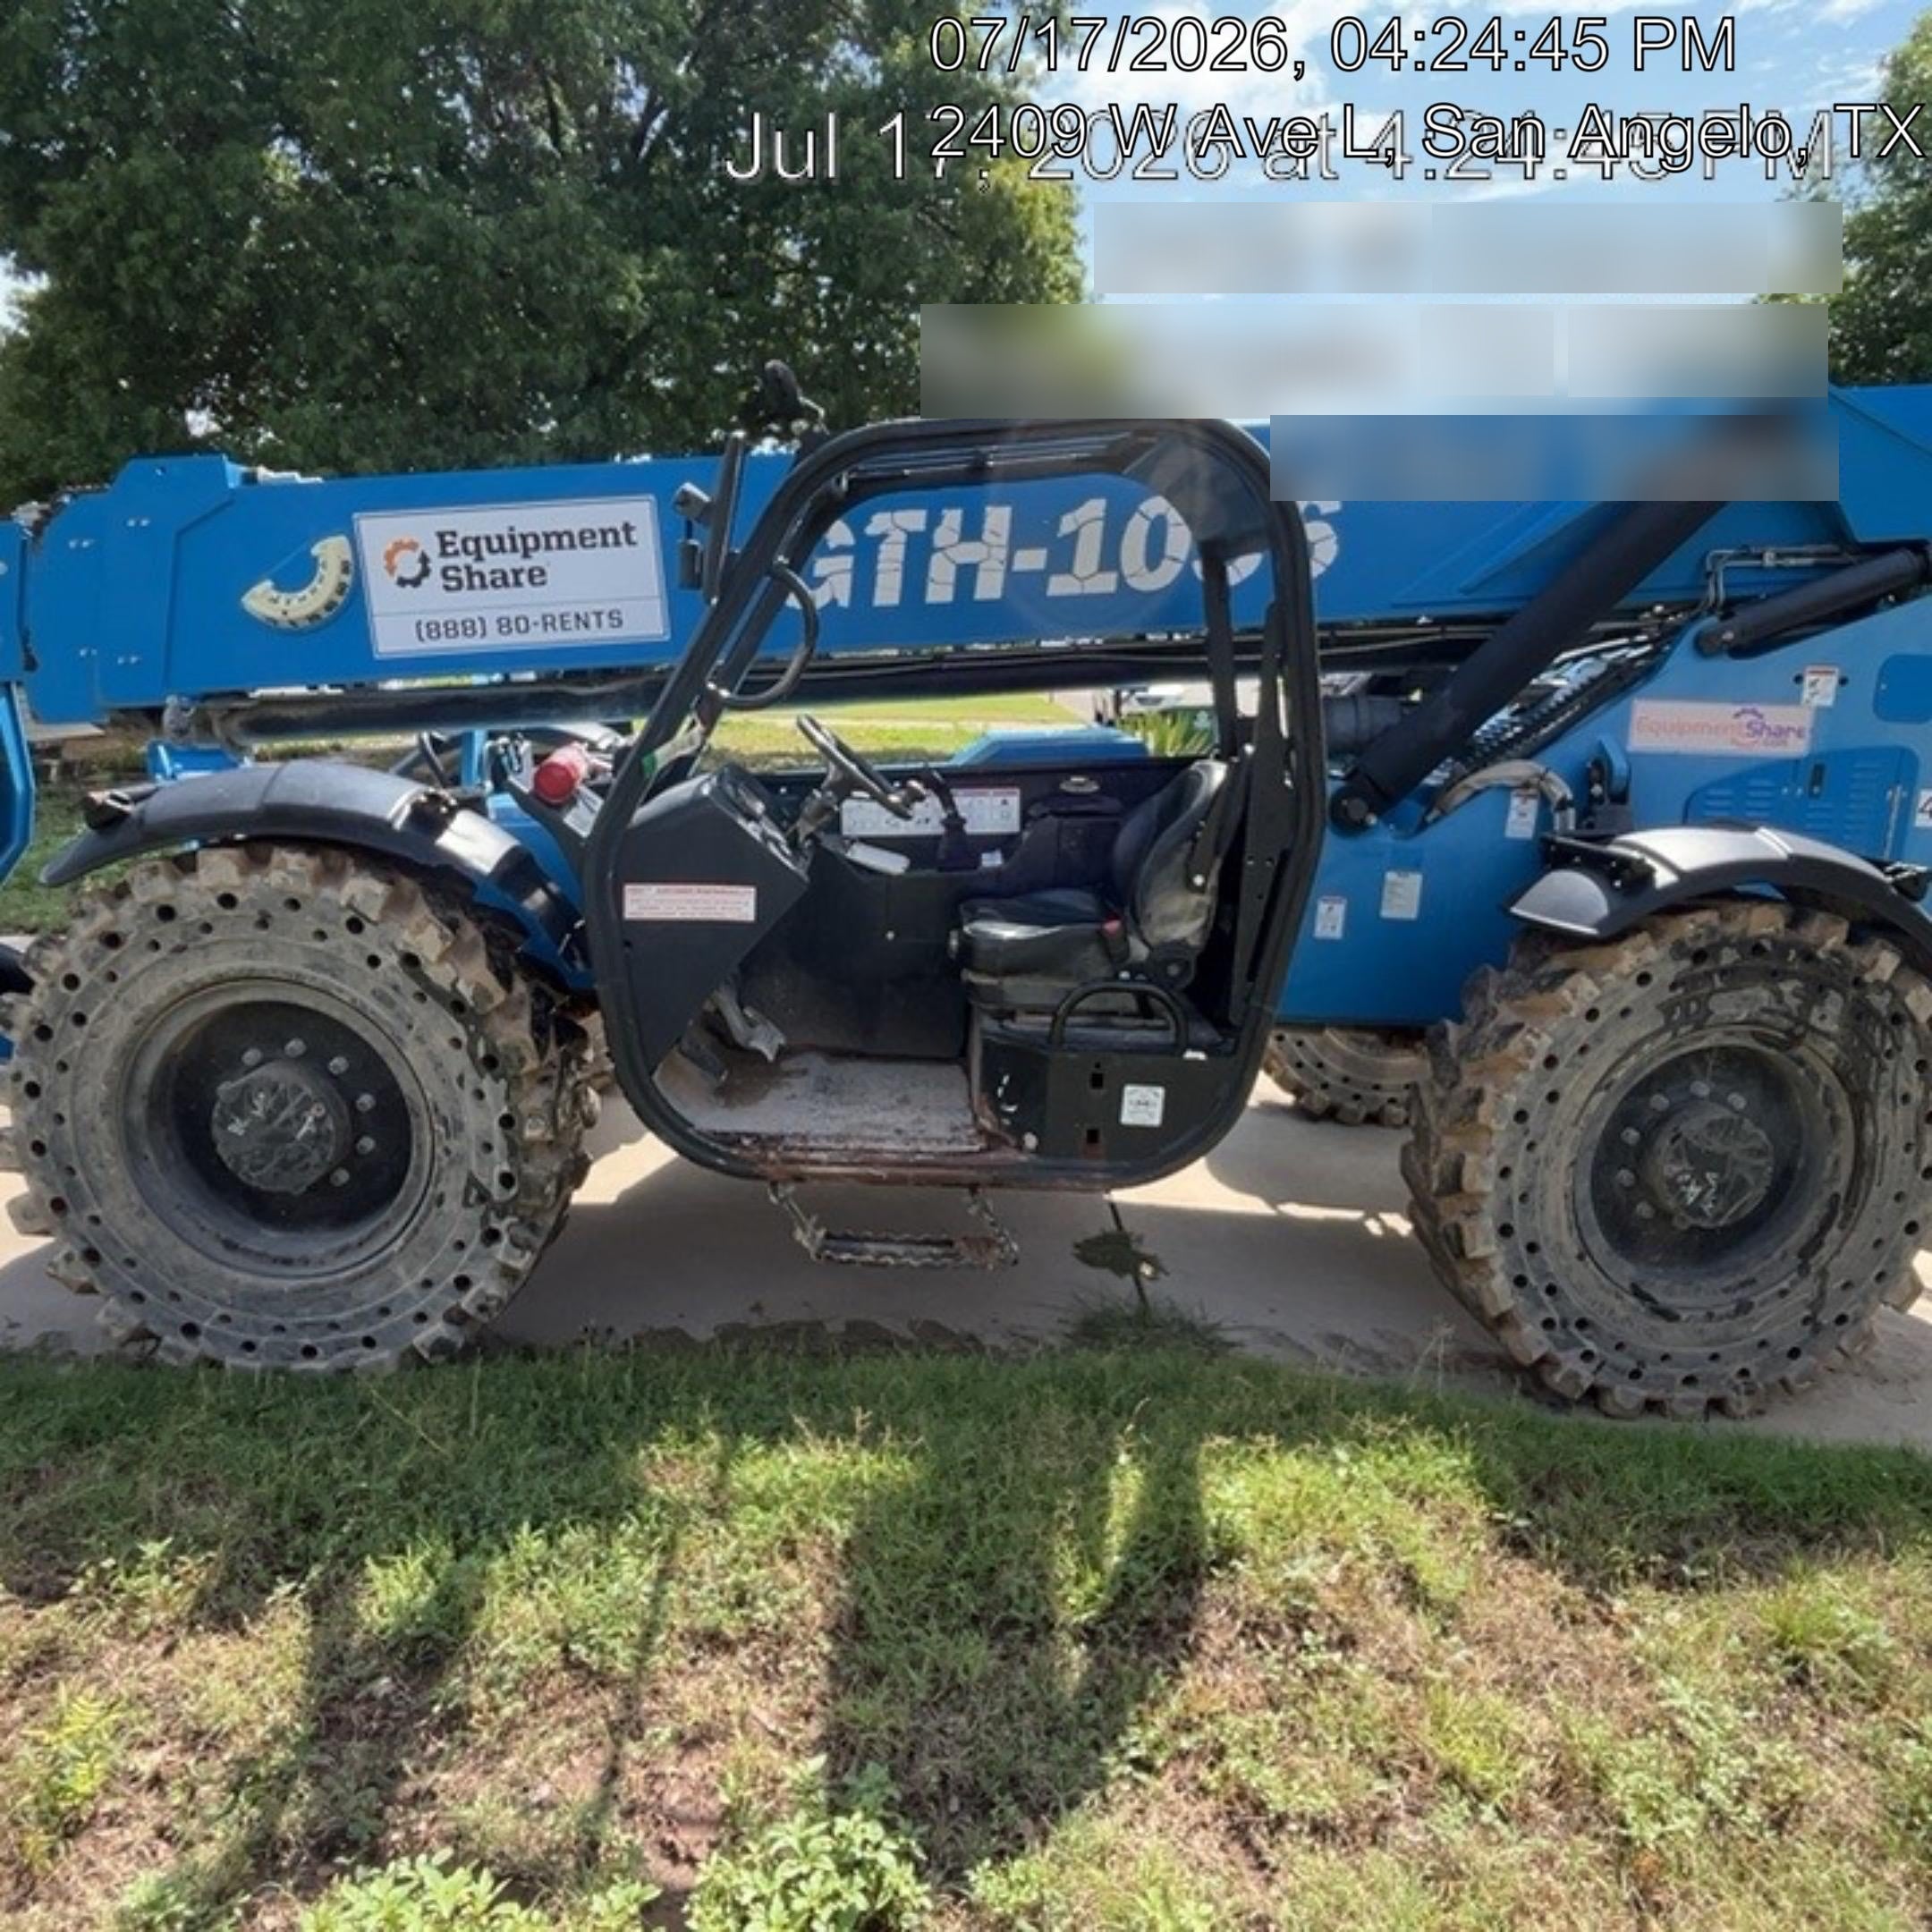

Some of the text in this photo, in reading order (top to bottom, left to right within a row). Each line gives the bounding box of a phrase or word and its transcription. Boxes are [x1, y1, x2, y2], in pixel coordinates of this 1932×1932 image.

[436, 521, 638, 561] Equipment
[439, 564, 547, 592] Share
[415, 609, 624, 642] (888) 80-RENTS
